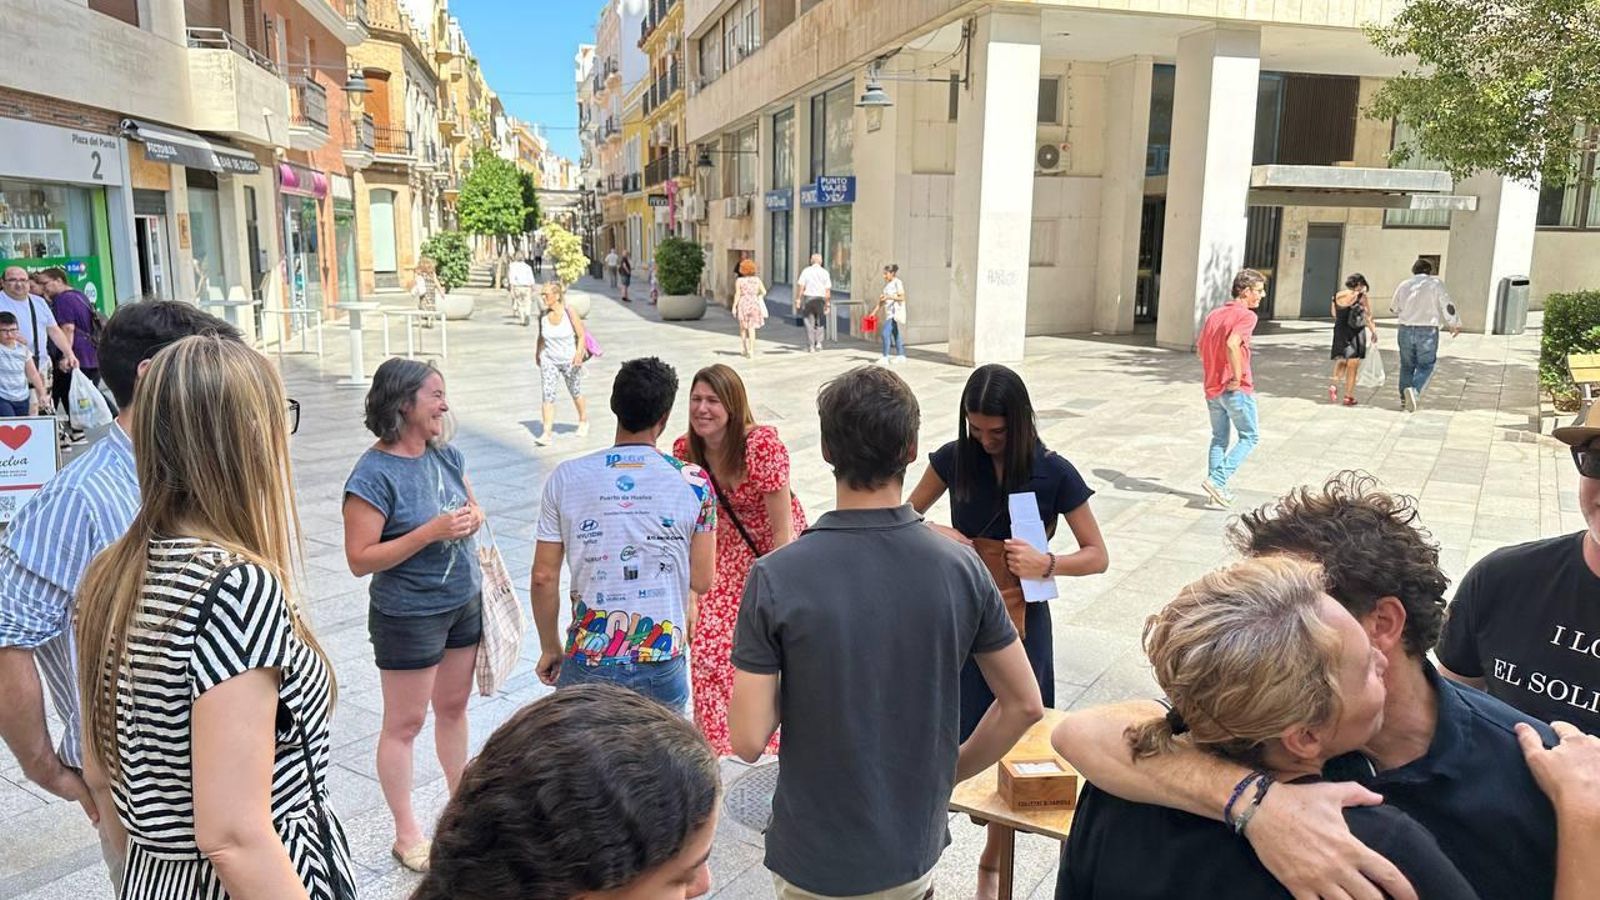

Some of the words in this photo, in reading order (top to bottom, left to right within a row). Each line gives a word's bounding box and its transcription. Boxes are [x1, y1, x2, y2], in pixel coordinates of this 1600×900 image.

[72, 133, 88, 145] Plaza
[90, 136, 98, 146] del
[99, 138, 116, 149] Punto
[91, 150, 103, 180] 2
[820, 177, 847, 185] PUNTO
[820, 184, 848, 192] VIAJES
[1550, 625, 1566, 646] I
[1494, 658, 1521, 686] EL
